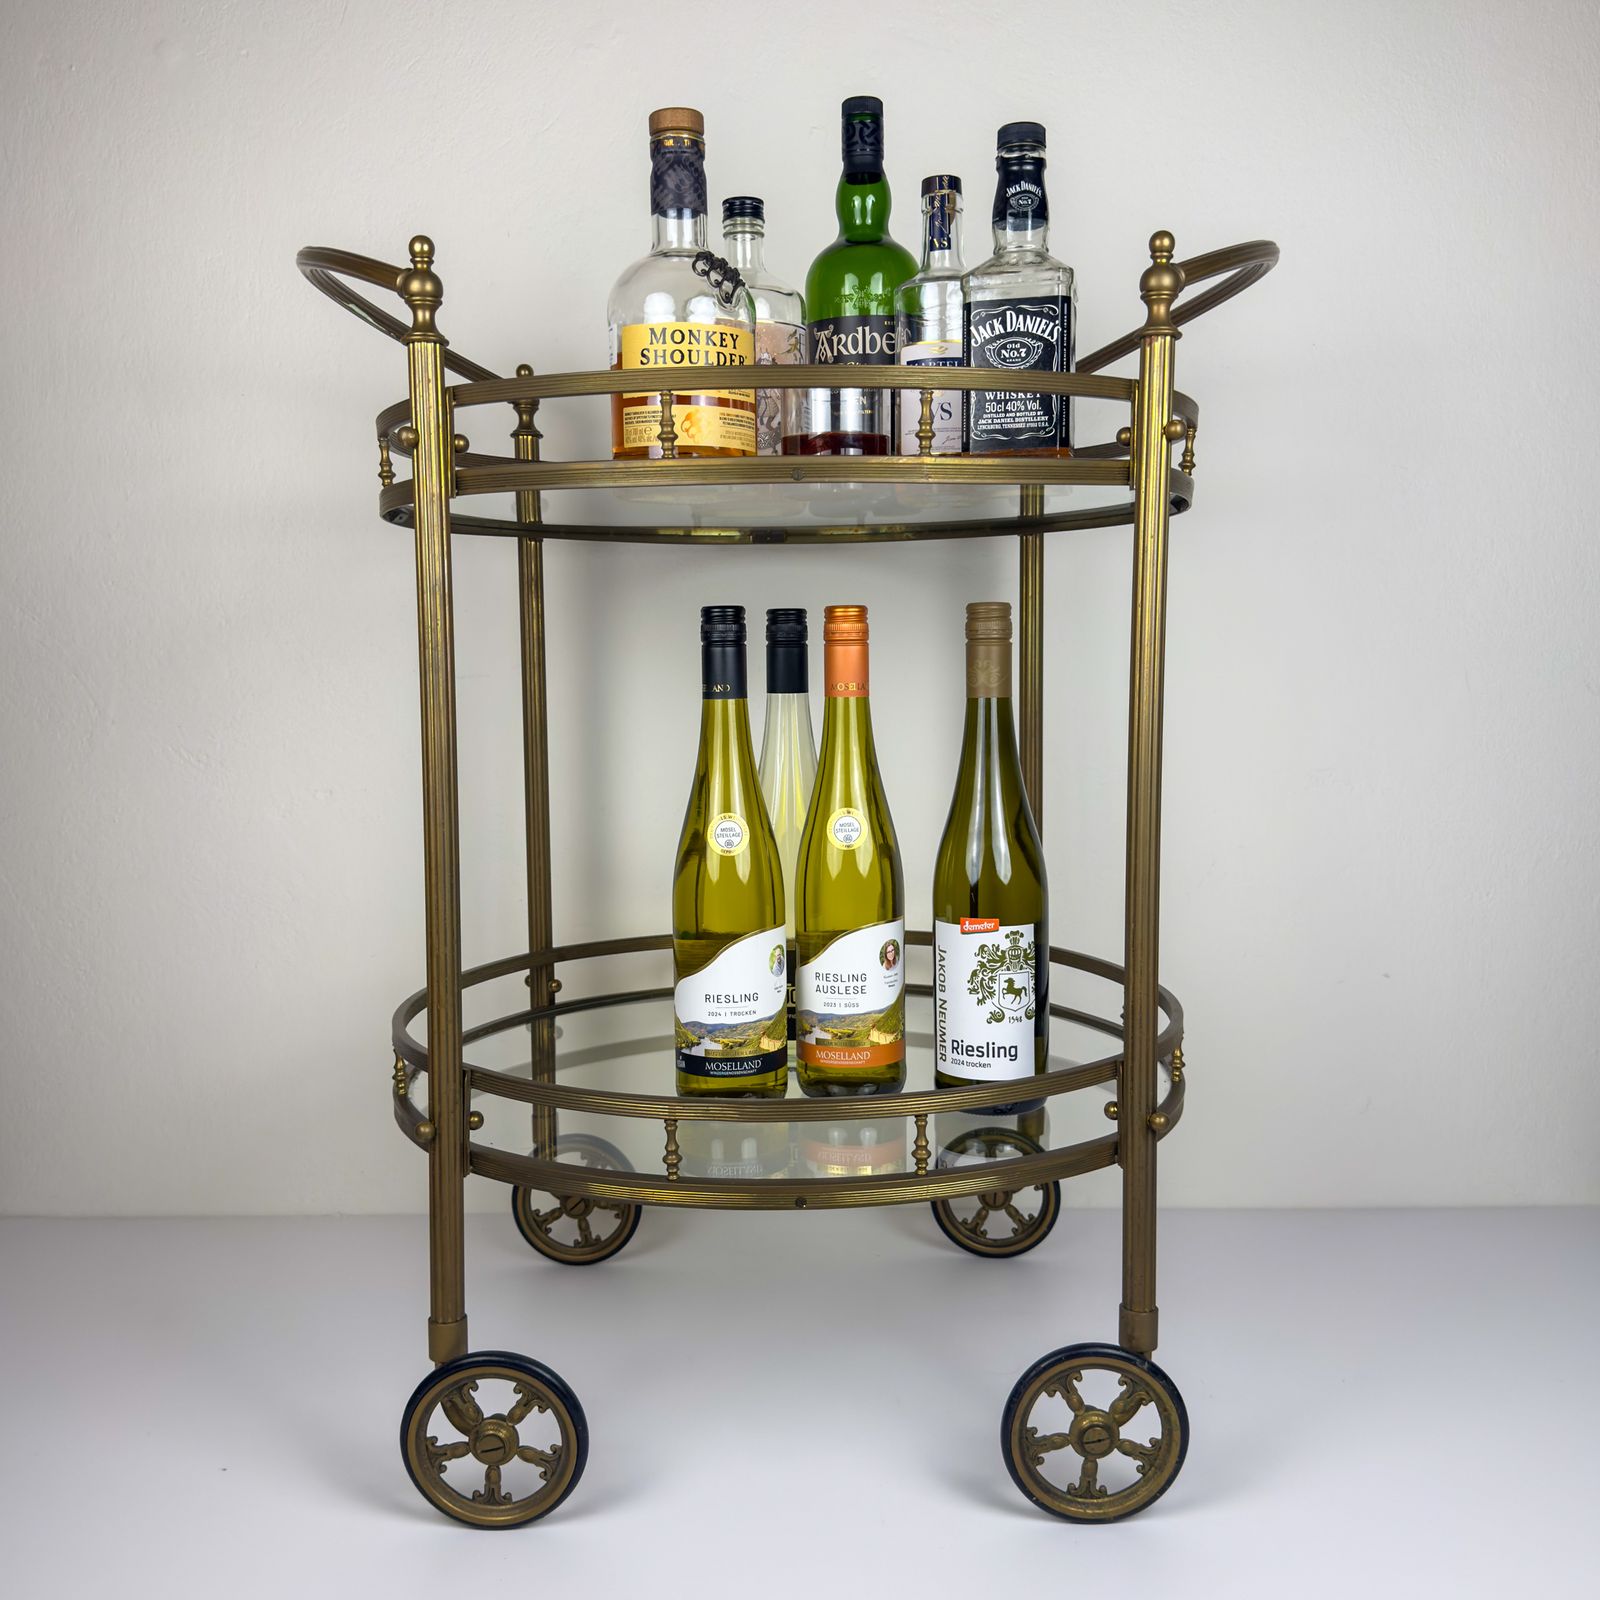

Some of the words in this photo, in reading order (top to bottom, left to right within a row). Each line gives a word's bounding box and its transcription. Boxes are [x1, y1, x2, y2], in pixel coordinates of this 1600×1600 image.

[1006, 184, 1021, 197] JACK
[970, 316, 1005, 347] JACK
[1006, 310, 1062, 342] DANIEL'S
[649, 327, 739, 350] MONKEY
[813, 324, 899, 364] Ardbe
[640, 347, 746, 367] SHOULDER
[1001, 348, 1027, 359] No.7
[985, 401, 1005, 413] 50cl
[1005, 400, 1025, 412] 40%
[1026, 399, 1042, 411] Vol.
[963, 921, 995, 931] demeter
[938, 945, 947, 993] JAKOB
[815, 972, 867, 983] RIESLING
[815, 984, 867, 995] AUSLESE
[704, 992, 759, 1004] RIESLING
[938, 999, 948, 1062] NEUMER
[815, 1050, 871, 1060] MOSELLAND
[951, 1039, 1018, 1062] Riesling
[705, 1060, 762, 1071] MOSELLAND
[950, 1057, 965, 1066] 2024
[965, 1060, 992, 1069] trocken
